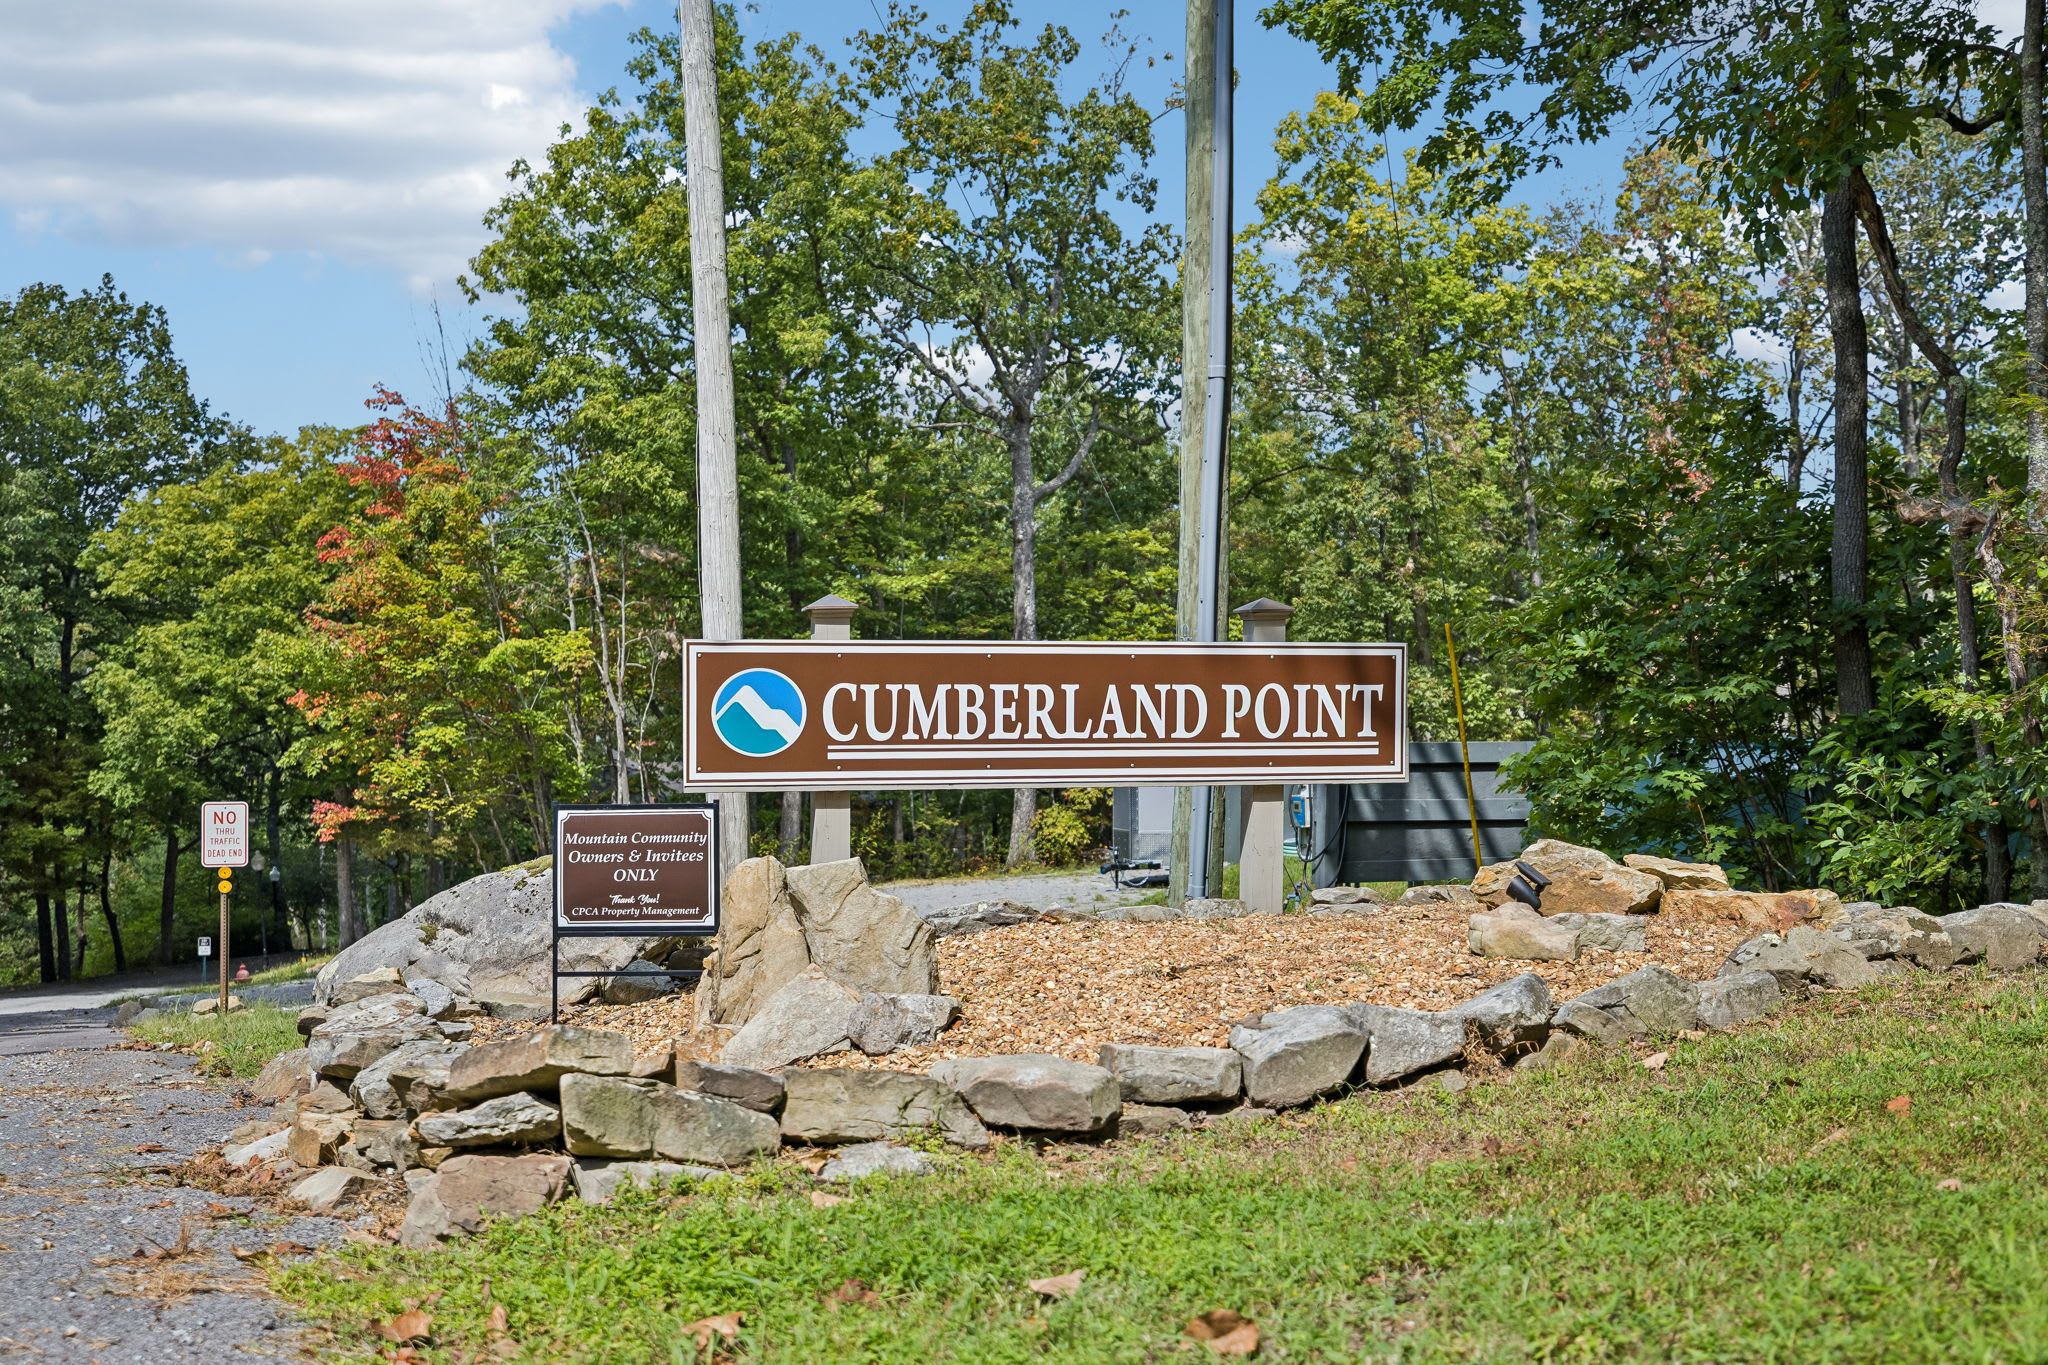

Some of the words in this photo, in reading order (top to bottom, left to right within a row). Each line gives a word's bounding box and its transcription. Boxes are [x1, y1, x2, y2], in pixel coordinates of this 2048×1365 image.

[822, 682, 1208, 741] CUMBERLAND
[1220, 683, 1384, 739] POINT
[214, 811, 236, 824] NO
[564, 833, 628, 845] Mountain
[631, 832, 708, 846] Community
[208, 849, 226, 857] DEAD
[229, 849, 242, 857] END
[568, 850, 624, 863] Owners
[628, 850, 642, 862] &
[646, 849, 704, 862] Invitees
[613, 869, 659, 882] ONLY
[609, 894, 635, 905] Thank
[637, 893, 660, 905] You!
[571, 907, 599, 916] CPCA
[601, 907, 640, 917] Property
[642, 906, 699, 917] Management
